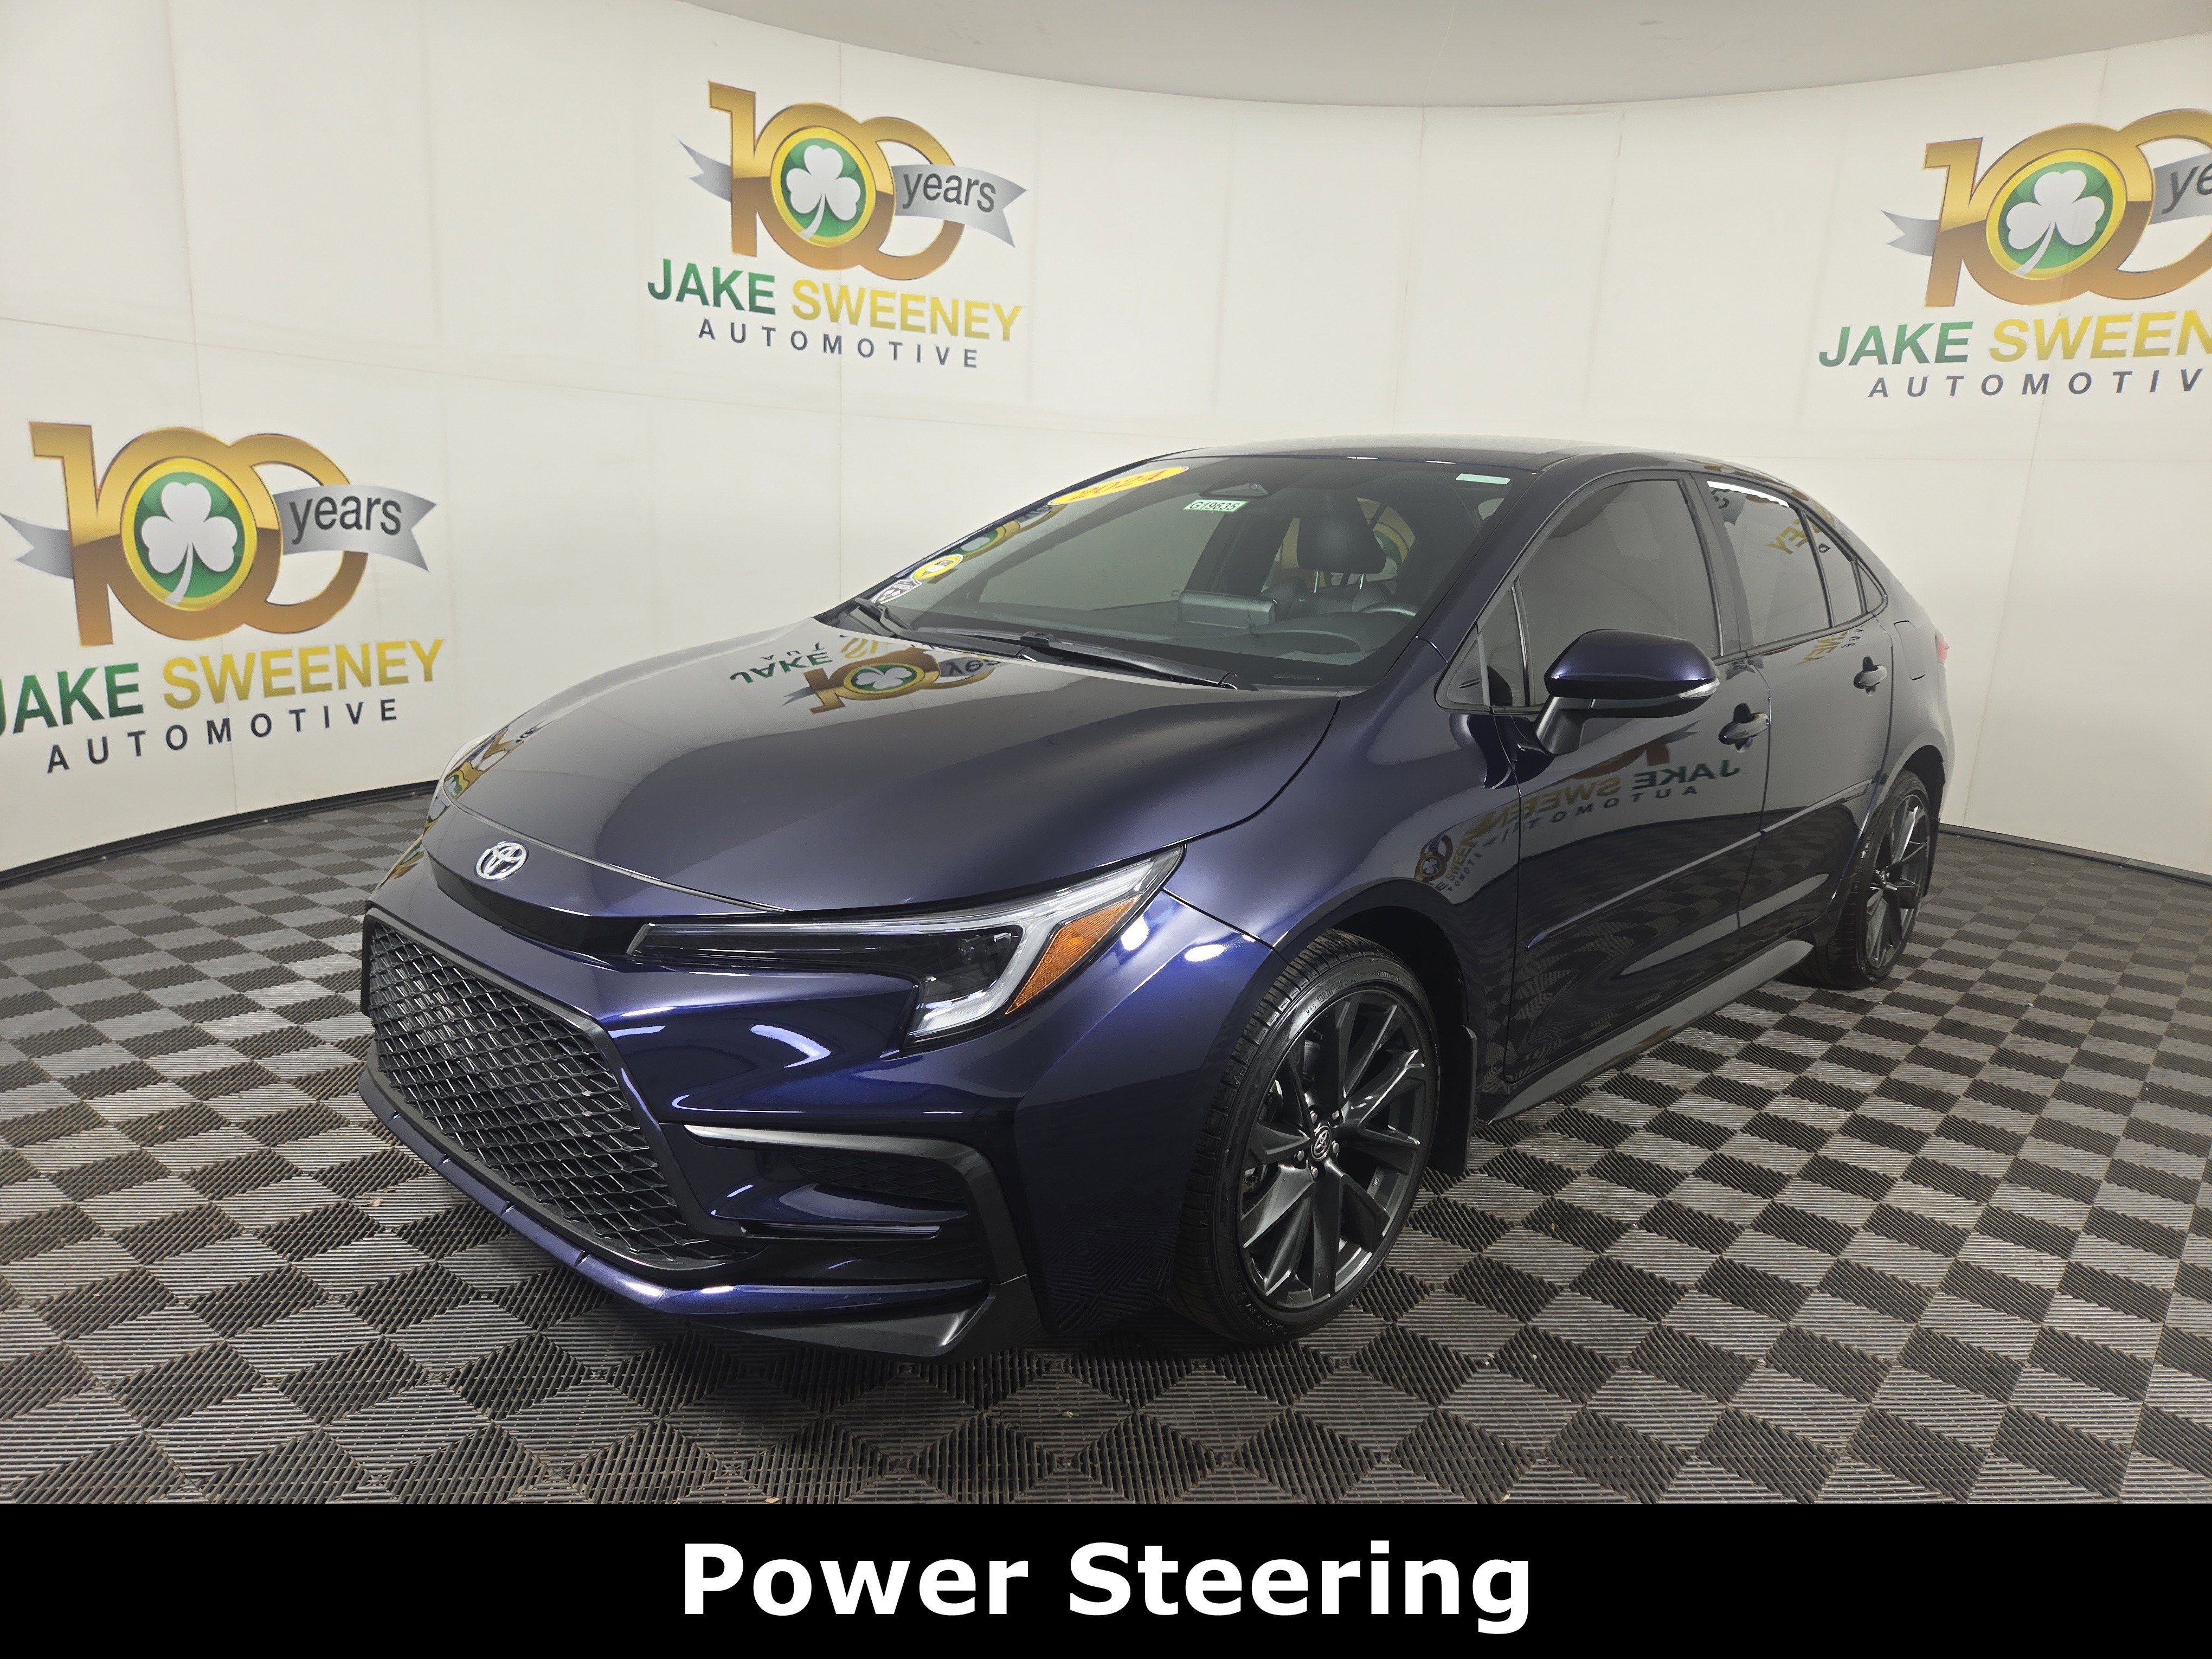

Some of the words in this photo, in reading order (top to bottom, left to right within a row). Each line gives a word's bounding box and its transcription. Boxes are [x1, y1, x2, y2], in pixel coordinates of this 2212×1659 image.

[708, 80, 967, 280] 100
[902, 170, 996, 213] years
[1921, 107, 2212, 308] 100
[647, 258, 775, 315] JAKE
[792, 279, 1022, 342] SWEENEY
[698, 319, 978, 368] AUTOMOTIVE
[1818, 321, 1973, 367] JAKE
[1068, 469, 1167, 501] 2024
[1189, 501, 1240, 511] G19635
[28, 421, 369, 648] 100
[288, 494, 402, 545] years
[162, 639, 445, 710] SWEENEY
[47, 698, 397, 774] AUTOMOTIVE
